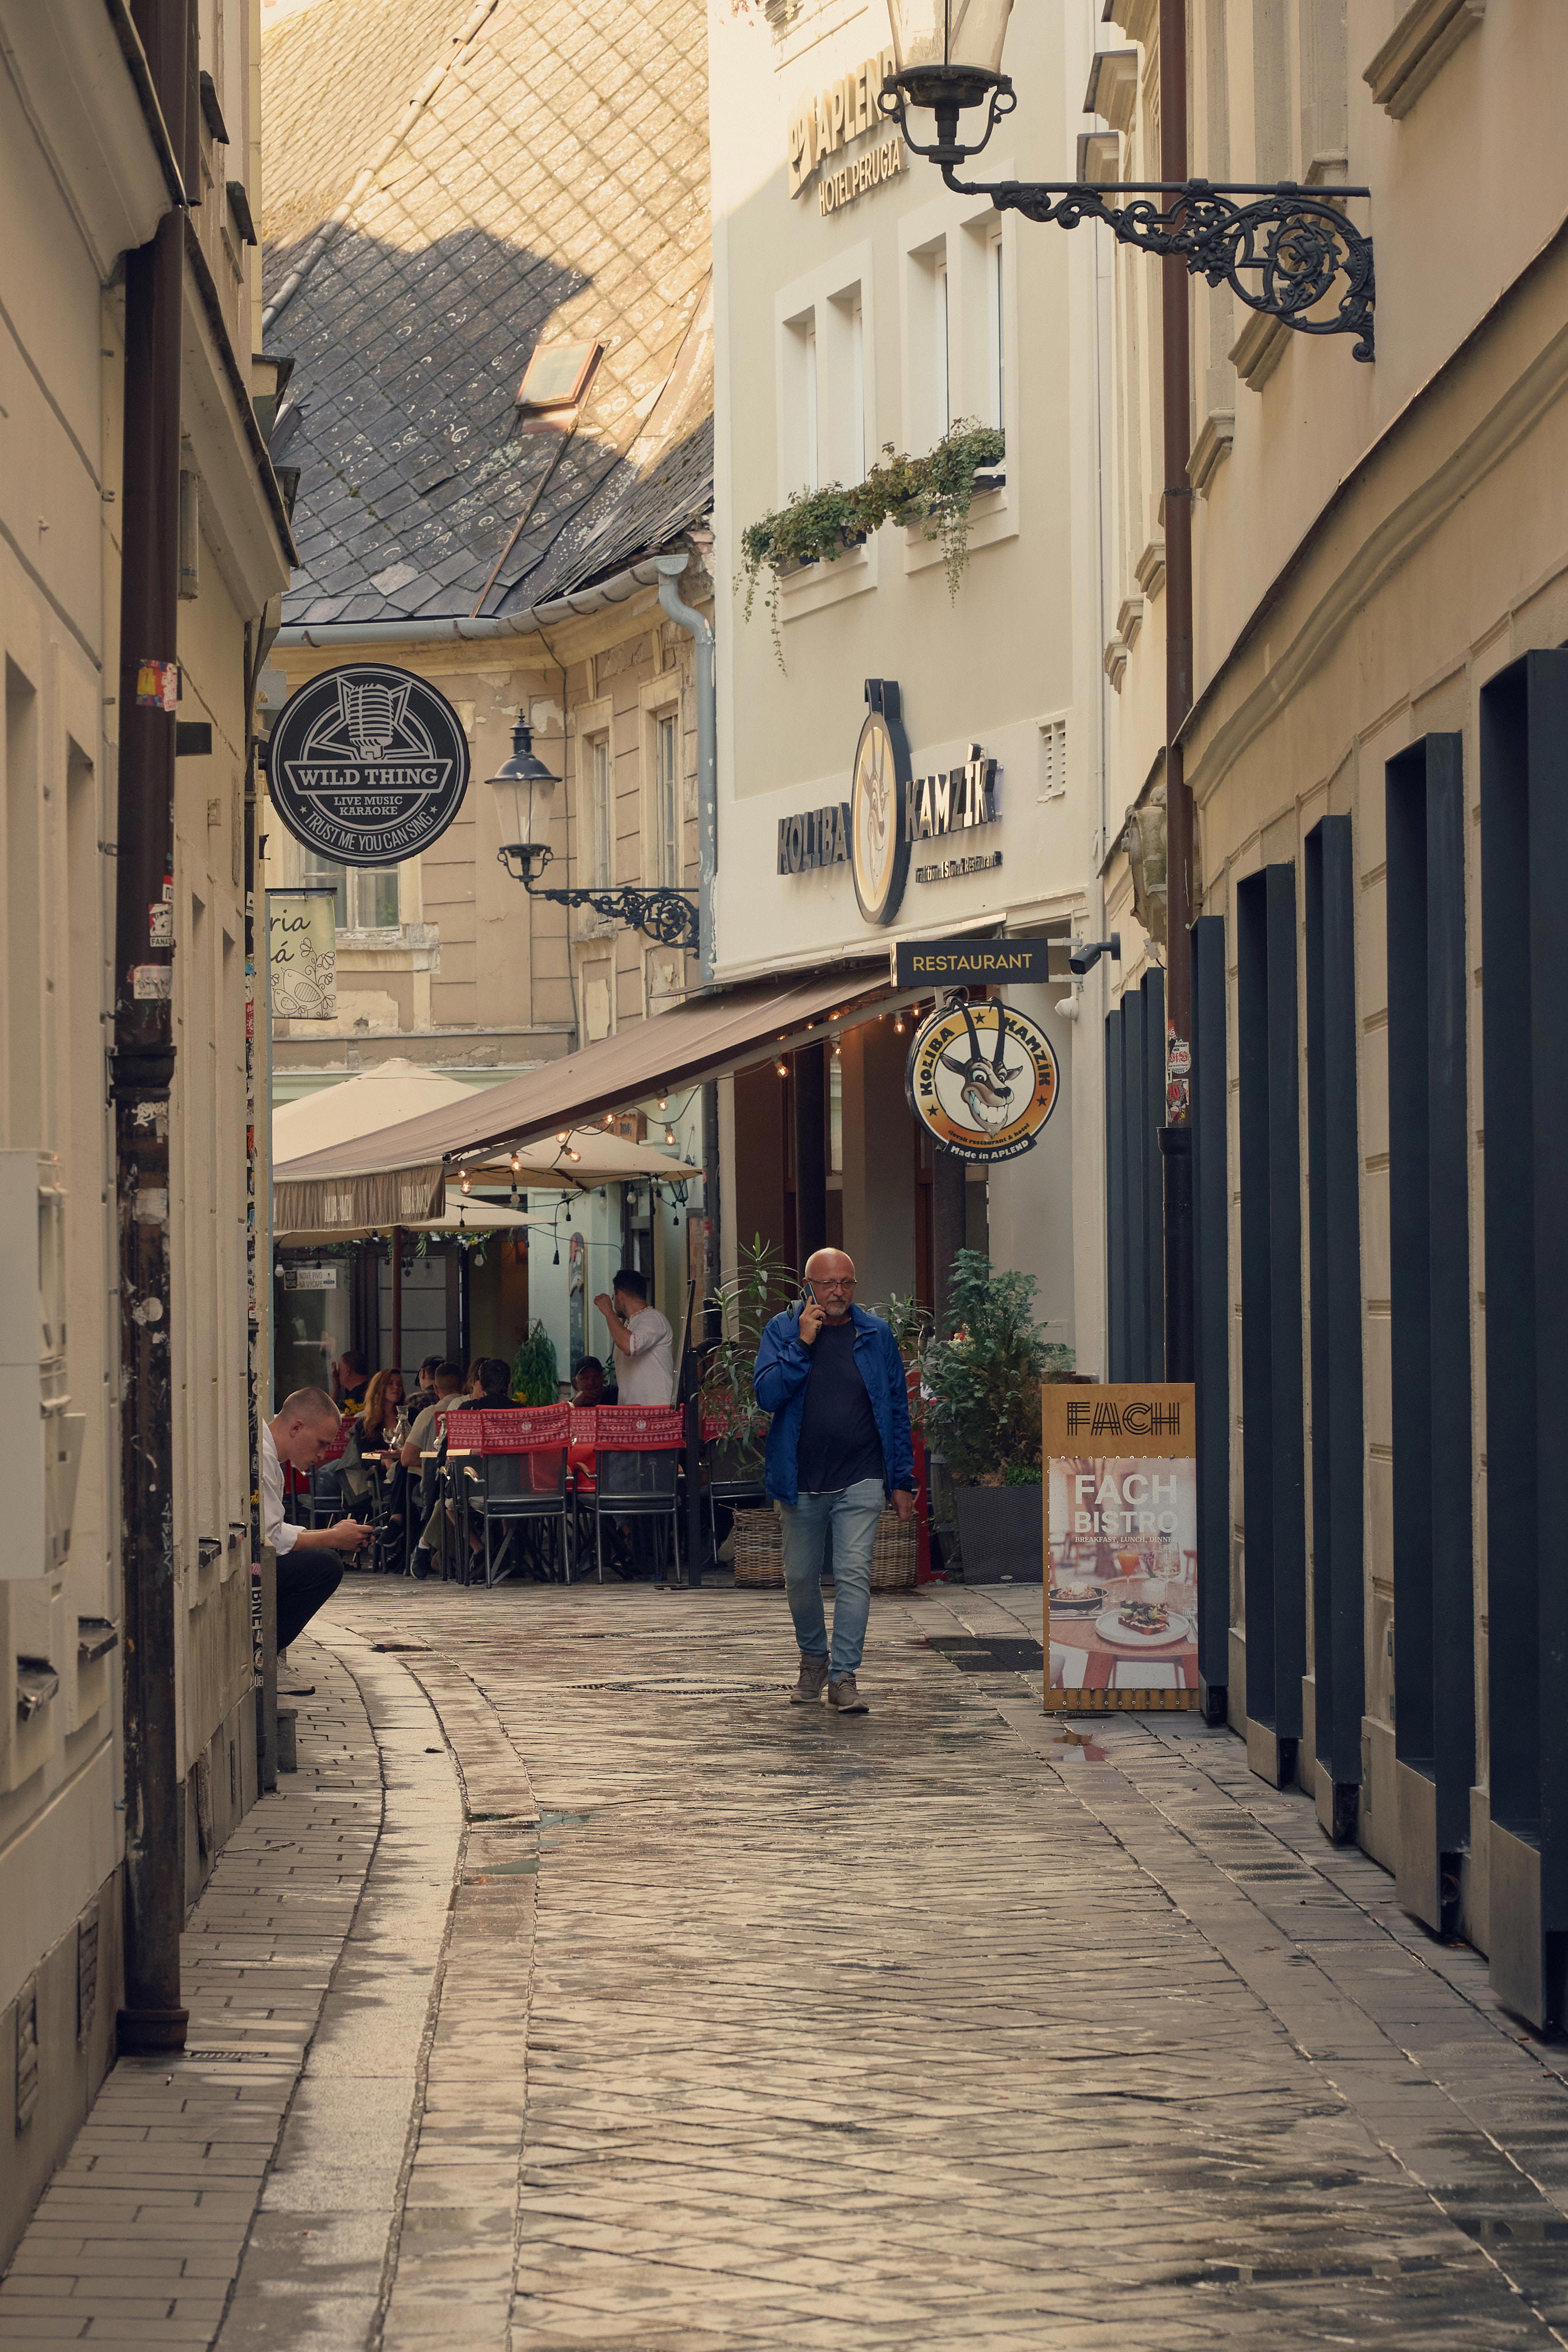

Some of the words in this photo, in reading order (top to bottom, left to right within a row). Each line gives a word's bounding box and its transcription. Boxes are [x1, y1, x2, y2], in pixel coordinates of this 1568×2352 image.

[818, 167, 852, 216] HOTEL
[852, 137, 905, 197] PERUGIA
[298, 769, 361, 786] WILD
[364, 768, 438, 785] THING
[334, 796, 362, 806] LIVE
[364, 796, 403, 805] MUSIC
[339, 806, 398, 815] KARAOKE
[777, 803, 850, 875] KOLIBA
[905, 743, 993, 842] KAMZÍK
[304, 811, 341, 843] TRUST
[338, 833, 357, 850] ME
[359, 834, 382, 852] YOU
[382, 827, 410, 850] CAN
[409, 811, 435, 839] SING
[913, 953, 1033, 971] RESTAURANT
[920, 1027, 955, 1096] KOLIBA
[1004, 1016, 1051, 1086] KAMZÍK
[969, 1137, 1007, 1146] restaurant
[1014, 1123, 1030, 1137] hotel
[950, 1146, 977, 1159] Made
[991, 1139, 1029, 1159] APLEND
[1067, 1402, 1180, 1436] FACH
[1075, 1475, 1177, 1504] FACH
[1074, 1511, 1177, 1534] BISTRO
